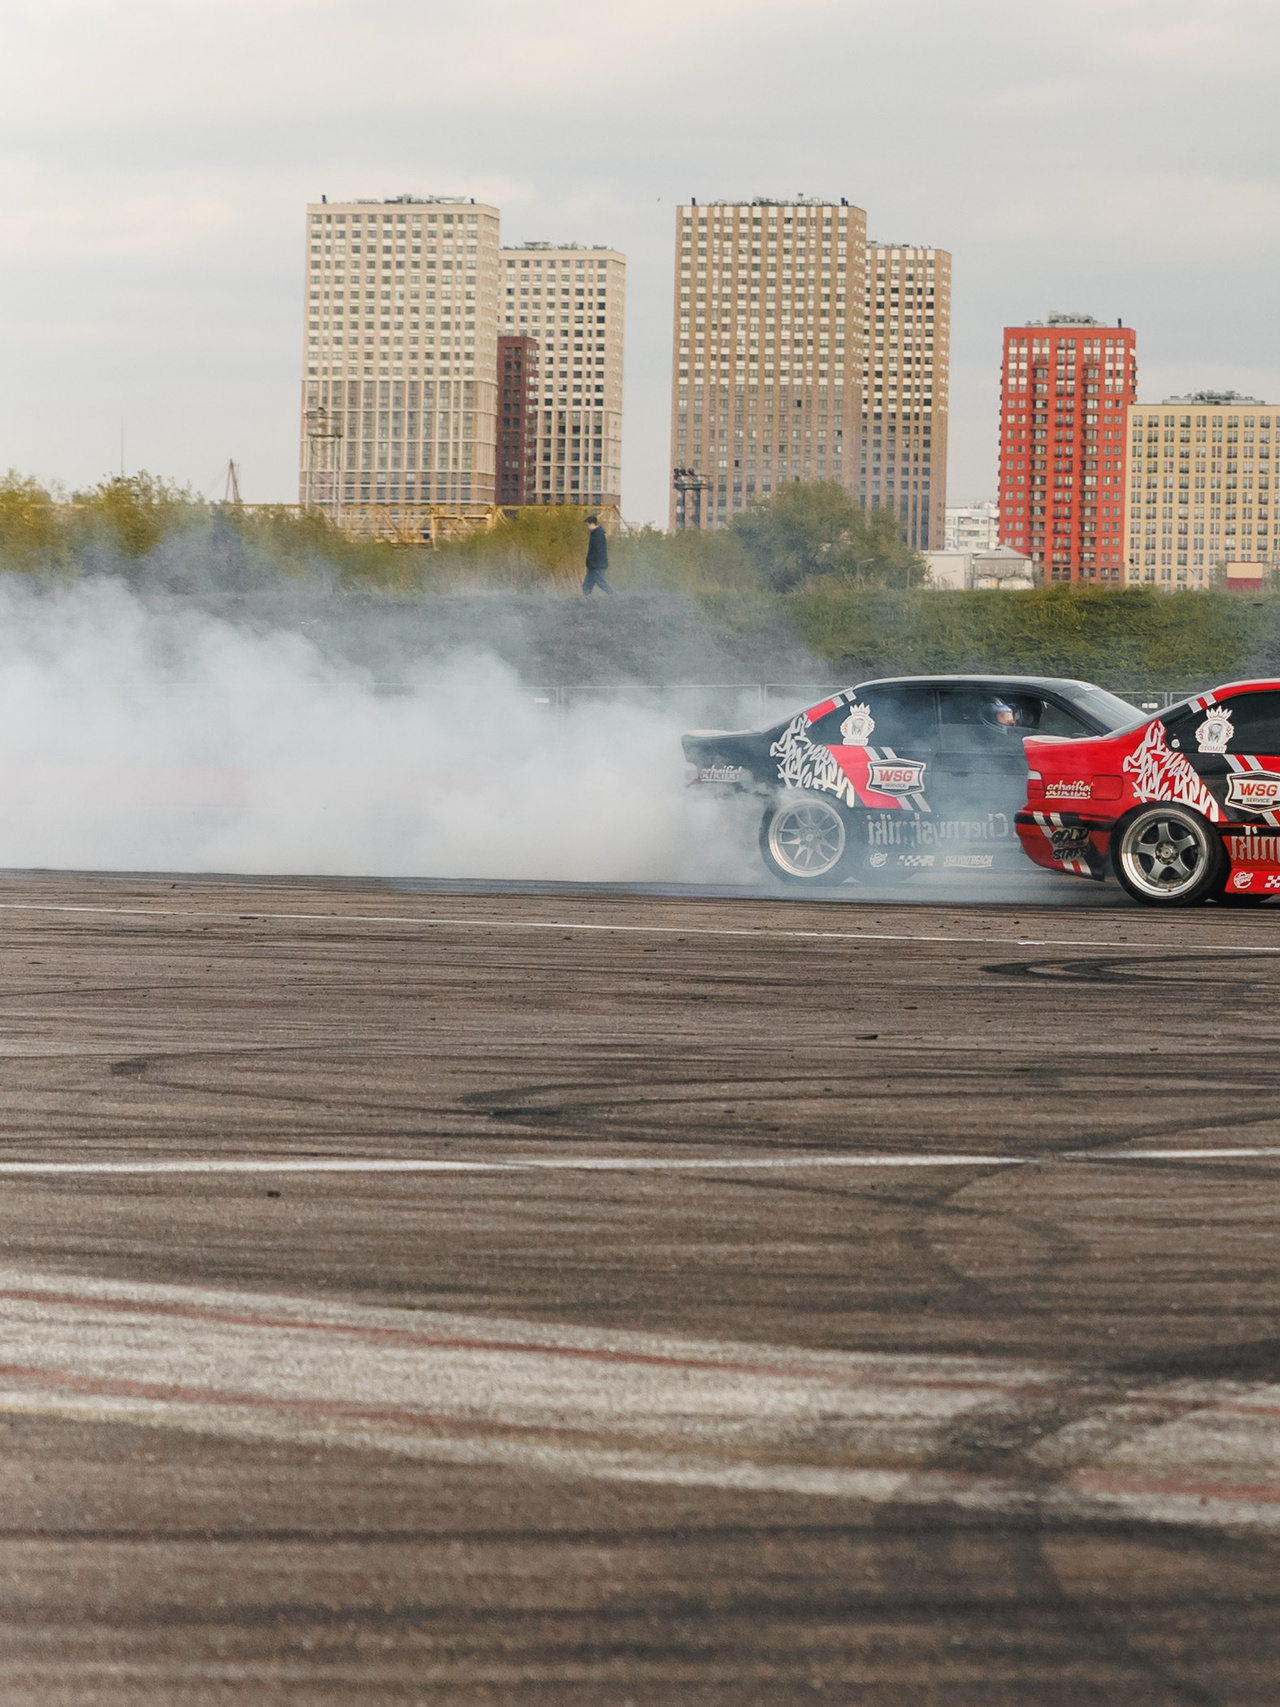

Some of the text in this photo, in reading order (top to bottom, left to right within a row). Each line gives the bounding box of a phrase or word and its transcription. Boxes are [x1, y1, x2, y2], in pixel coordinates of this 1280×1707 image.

[878, 769, 914, 782] WSG
[1239, 783, 1278, 797] WSG
[1051, 828, 1089, 843] GOLD
